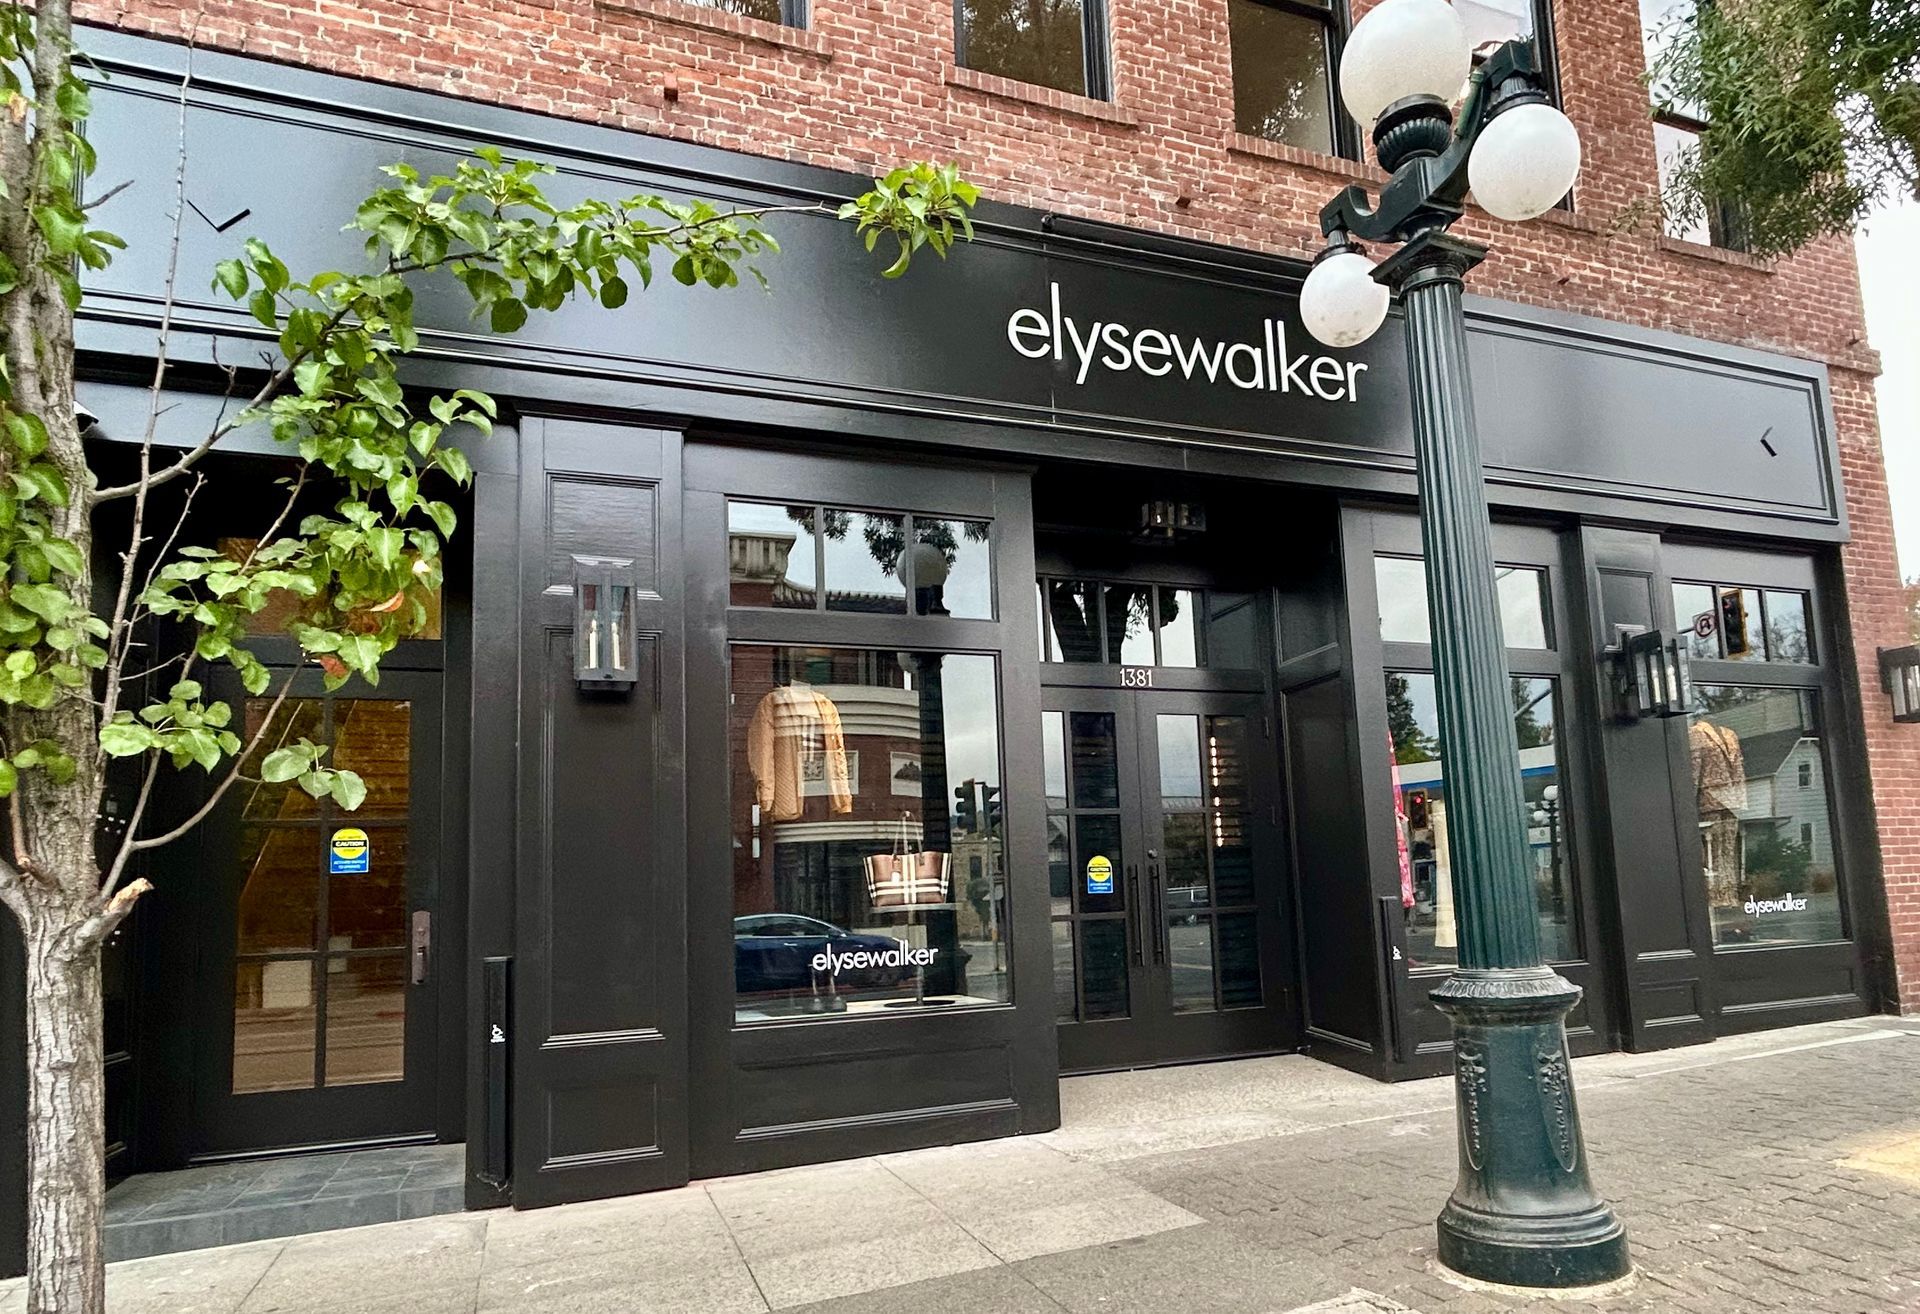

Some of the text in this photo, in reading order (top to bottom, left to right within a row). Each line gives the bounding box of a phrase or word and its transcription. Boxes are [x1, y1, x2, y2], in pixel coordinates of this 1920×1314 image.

[1007, 282, 1368, 402] elysewalker
[1119, 668, 1153, 687] 1381
[1744, 892, 1808, 918] elysewalker
[812, 939, 938, 977] elysewalker
